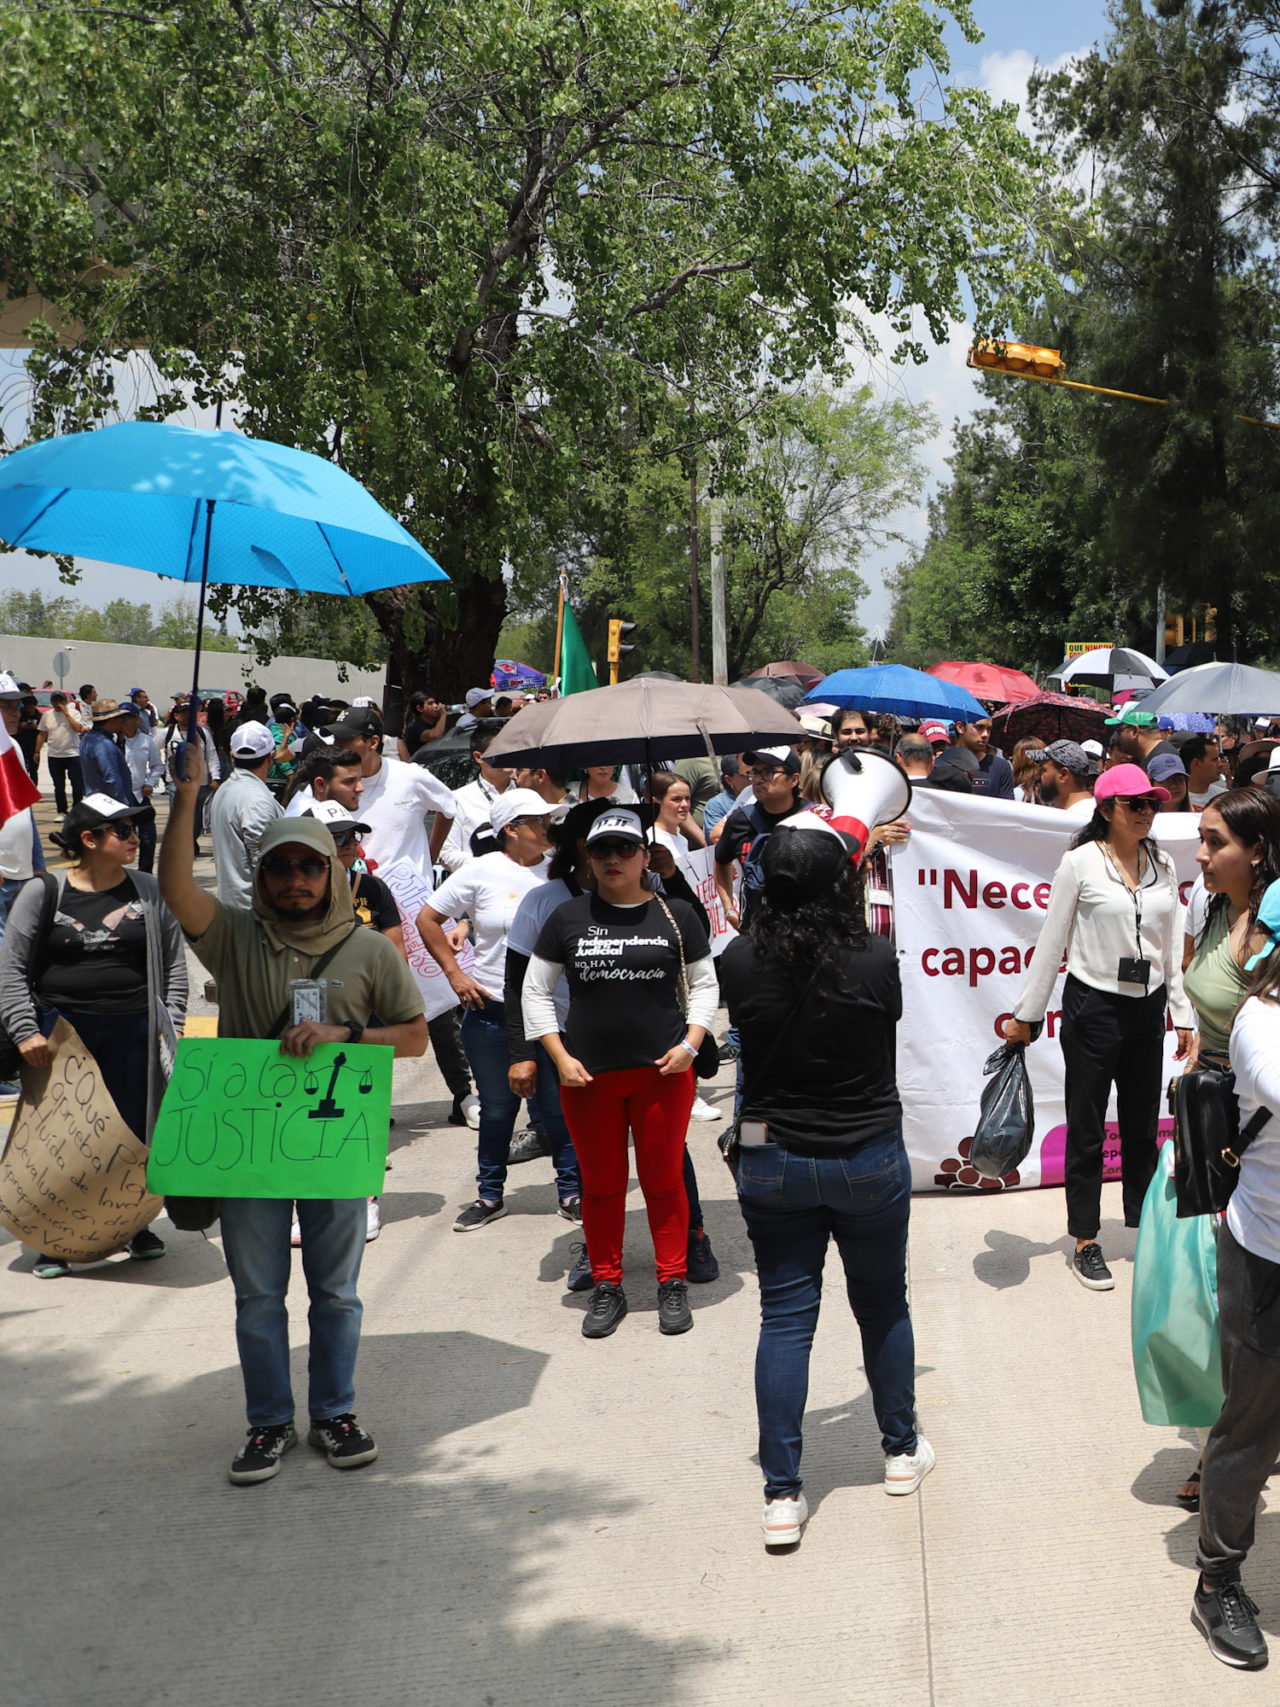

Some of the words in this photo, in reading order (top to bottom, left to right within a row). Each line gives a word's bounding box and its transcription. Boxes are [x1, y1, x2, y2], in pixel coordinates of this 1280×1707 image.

[588, 925, 609, 937] Sin
[577, 935, 669, 950] Independencia
[575, 945, 624, 957] Judicial
[575, 961, 587, 969] NO
[590, 960, 616, 969] HAY
[580, 966, 667, 982] democracia
[224, 1063, 247, 1098] a
[258, 1055, 297, 1099] la
[51, 1082, 103, 1176] aprueba
[70, 1171, 89, 1194] de
